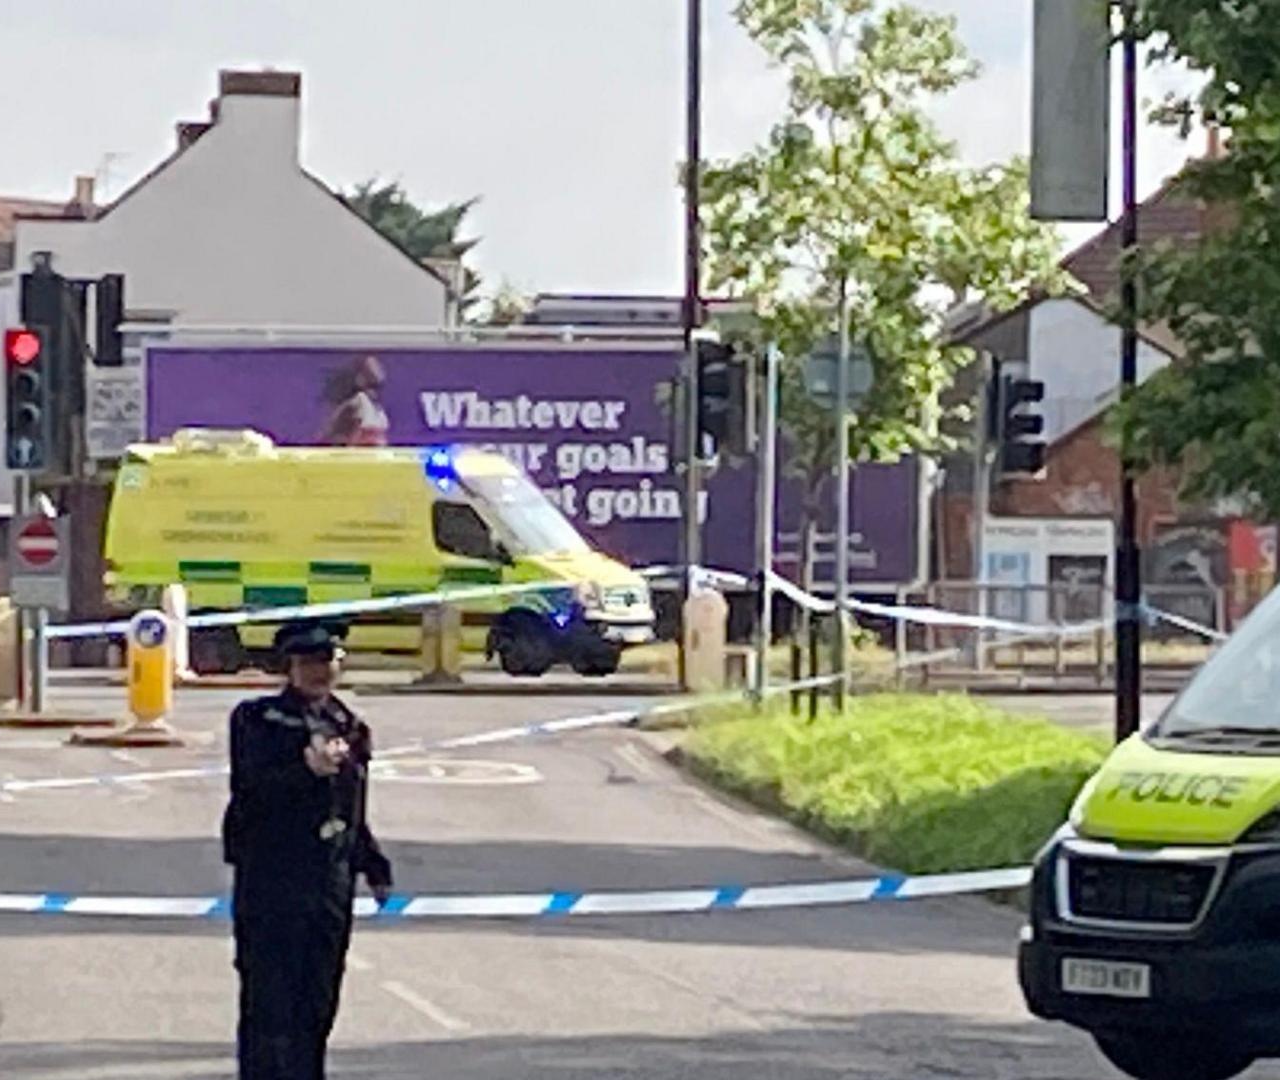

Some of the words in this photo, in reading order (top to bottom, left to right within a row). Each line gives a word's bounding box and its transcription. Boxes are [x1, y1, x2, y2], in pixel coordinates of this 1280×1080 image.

[422, 392, 625, 430] Whatever
[557, 436, 668, 478] goals
[1106, 772, 1248, 808] POLICE
